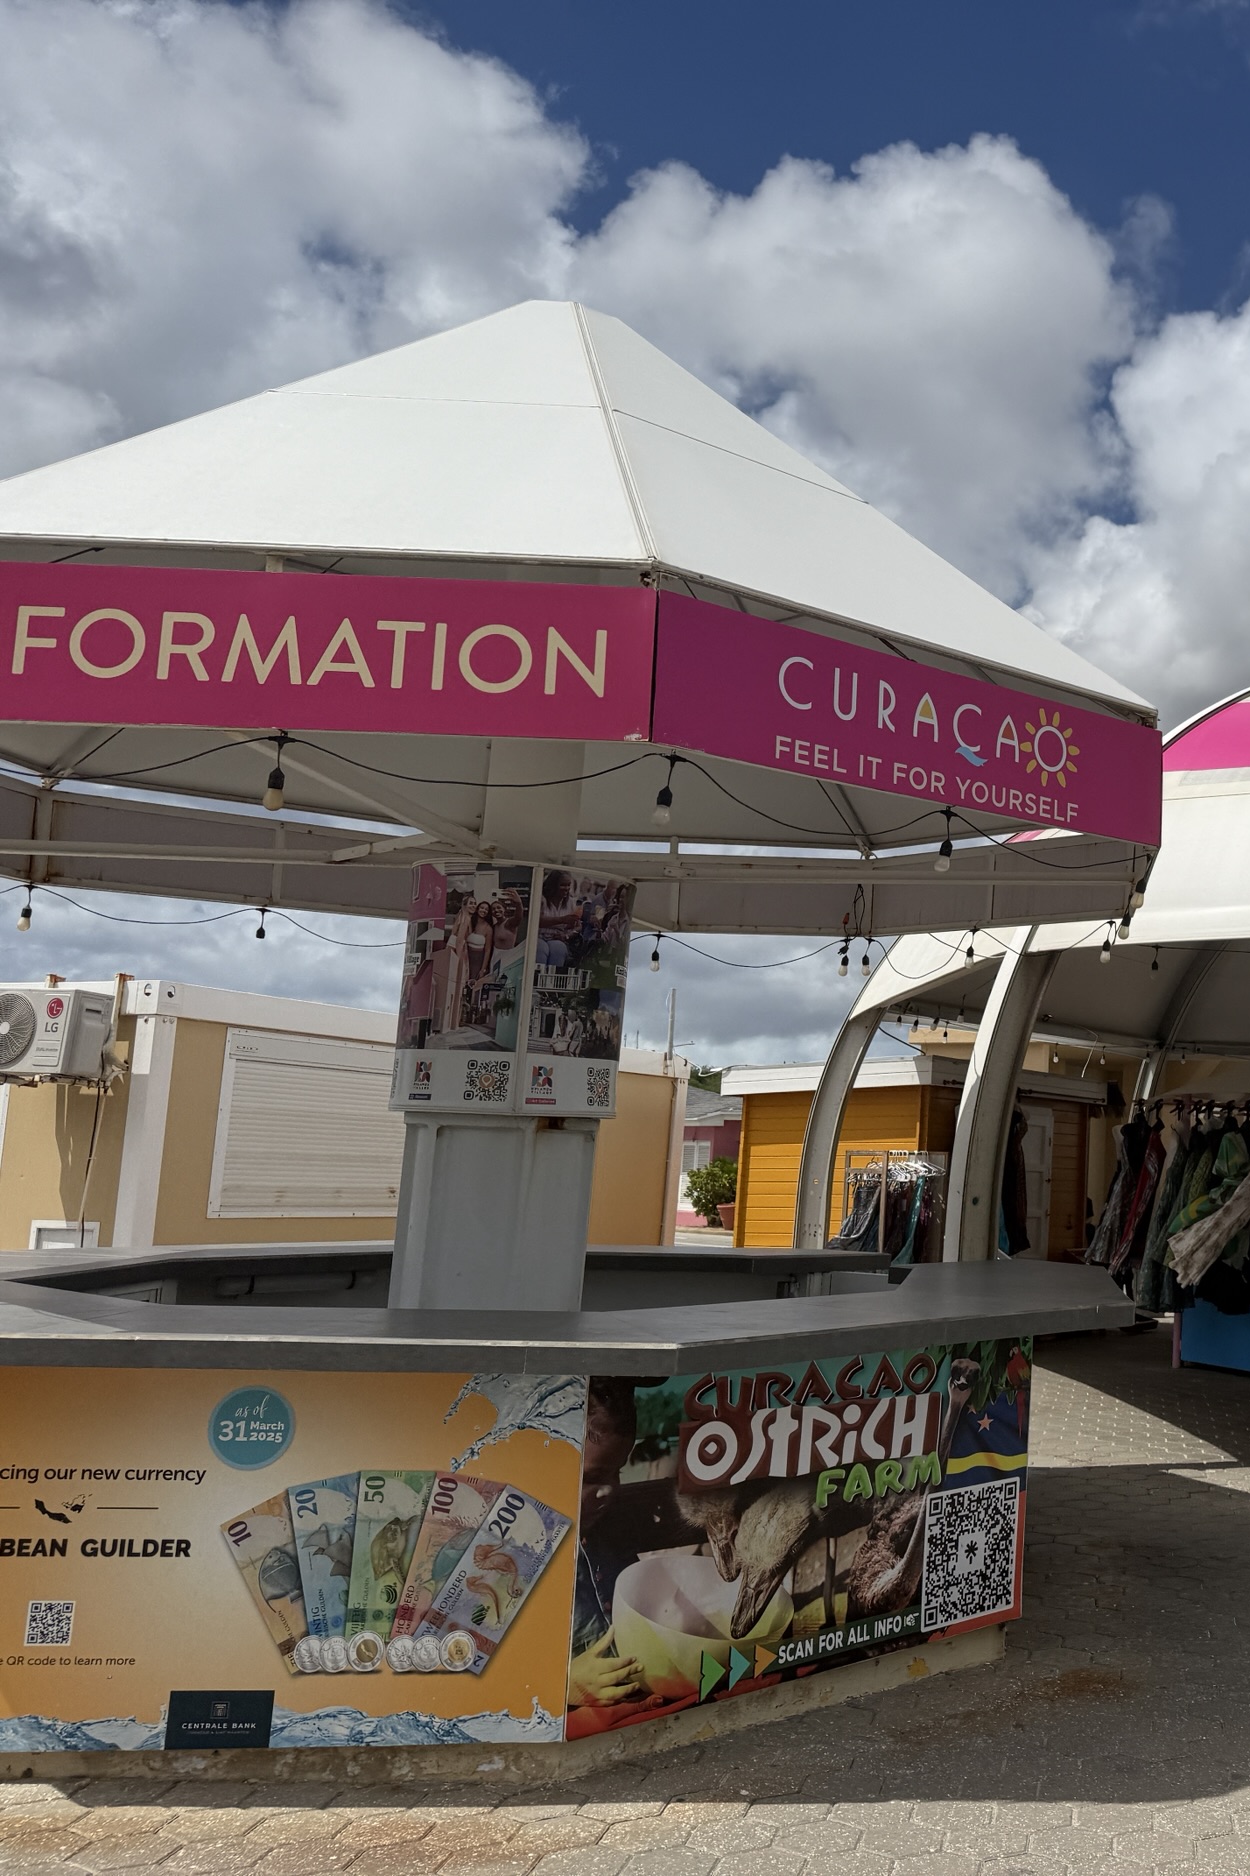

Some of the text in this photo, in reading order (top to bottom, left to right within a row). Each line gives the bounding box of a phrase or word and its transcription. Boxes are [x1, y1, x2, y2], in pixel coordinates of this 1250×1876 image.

[11, 605, 607, 698] FORMATION
[775, 736, 1079, 823] FEEL IT FOR YOURSELF
[45, 1022, 59, 1033] LG
[235, 1394, 270, 1419] as of
[218, 1420, 284, 1441] 31 March
[249, 1432, 283, 1443] 2025
[0, 1464, 207, 1485] cing our new currency
[816, 1451, 942, 1509] FARM
[295, 1489, 319, 1519] 20
[364, 1475, 386, 1504] 50
[430, 1477, 459, 1516] 100
[488, 1493, 526, 1540] 200
[0, 1538, 192, 1558] BEAN GUILDER
[227, 1521, 253, 1548] 10
[310, 1607, 320, 1637] INTIG
[396, 1585, 415, 1634] HONDERD
[778, 1615, 902, 1664] SCAN FOR ALL INFO
[6, 1655, 25, 1666] QR
[27, 1656, 56, 1666] code
[59, 1657, 71, 1666] to
[74, 1656, 102, 1666] learn
[105, 1657, 136, 1666] more
[182, 1722, 228, 1730] CENTRALE
